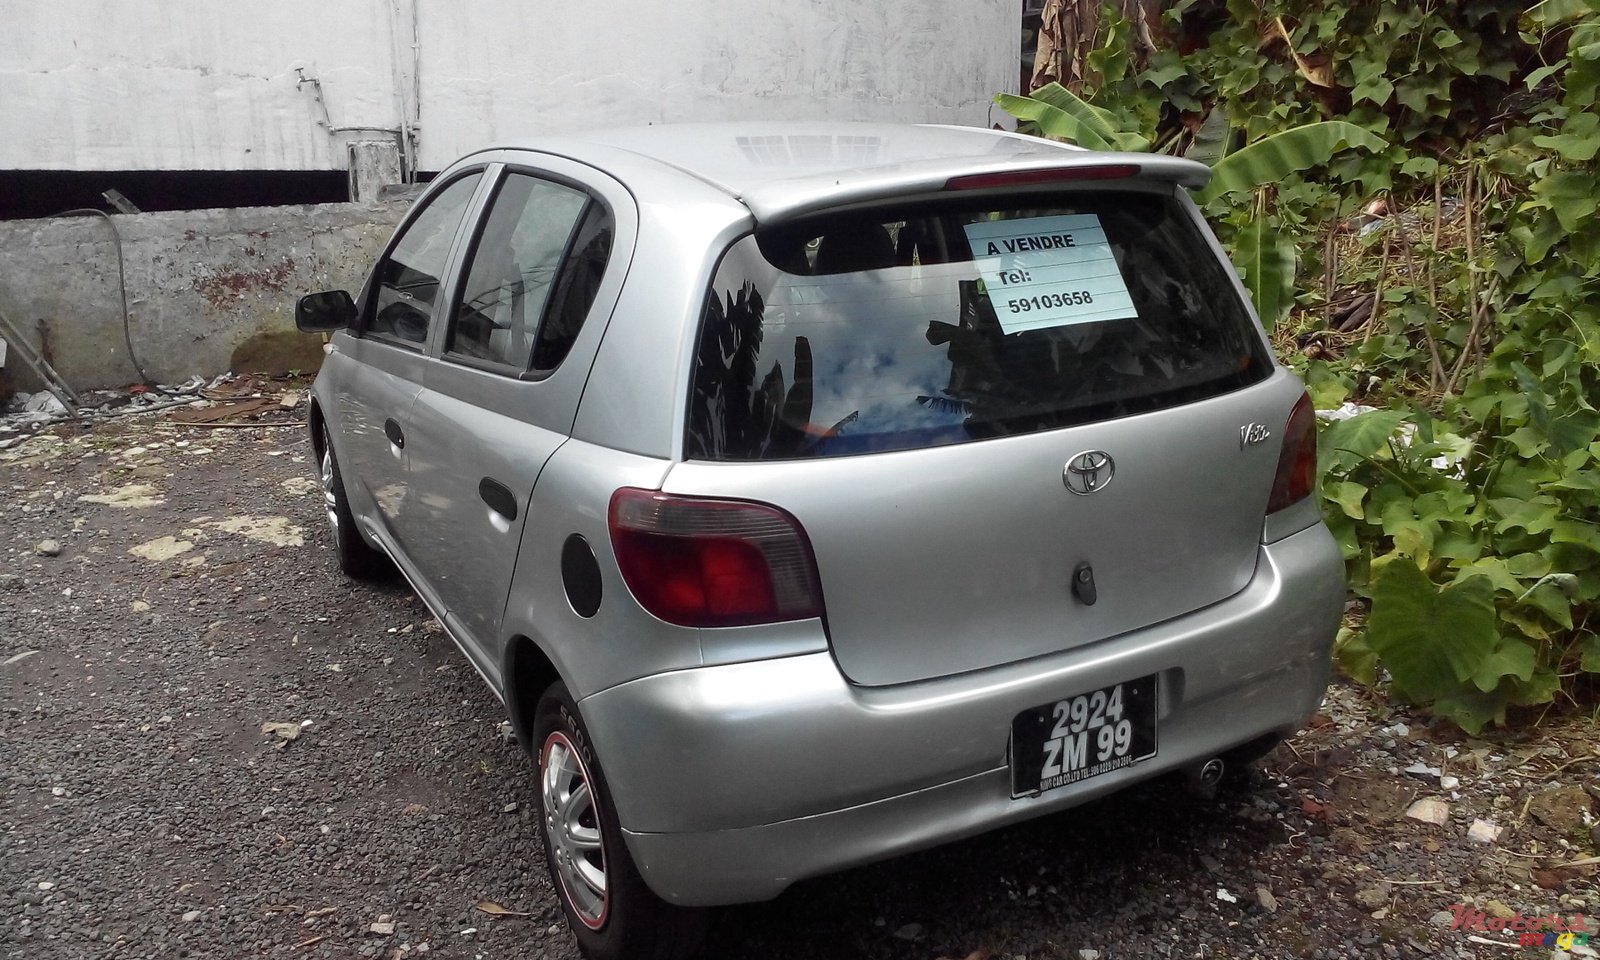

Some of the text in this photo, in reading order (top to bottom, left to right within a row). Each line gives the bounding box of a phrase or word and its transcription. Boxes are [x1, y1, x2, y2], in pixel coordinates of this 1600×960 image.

[987, 234, 1076, 255] A VENDRE
[998, 270, 1032, 285] Tel:
[1008, 290, 1093, 314] 59103658
[1050, 684, 1123, 739] 2924
[1041, 719, 1132, 779] ZM 99
